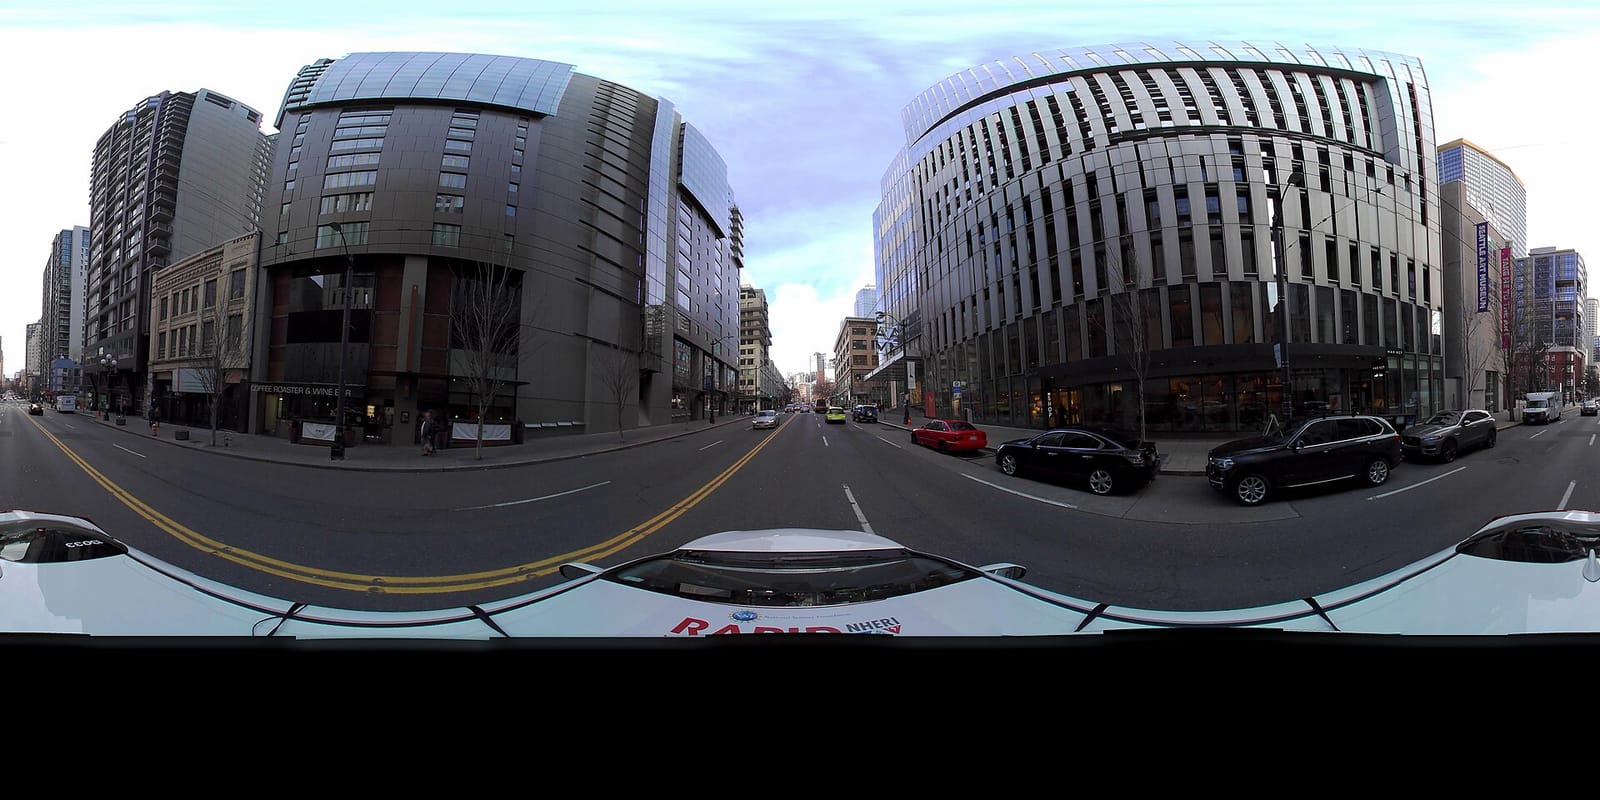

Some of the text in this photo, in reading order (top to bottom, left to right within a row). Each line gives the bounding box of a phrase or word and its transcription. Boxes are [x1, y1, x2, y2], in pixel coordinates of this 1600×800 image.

[1478, 225, 1487, 309] SEATTLE ART MUSEUM
[251, 384, 351, 397] COFFEE ROASTER & WINE BR
[846, 617, 900, 632] NHERI
